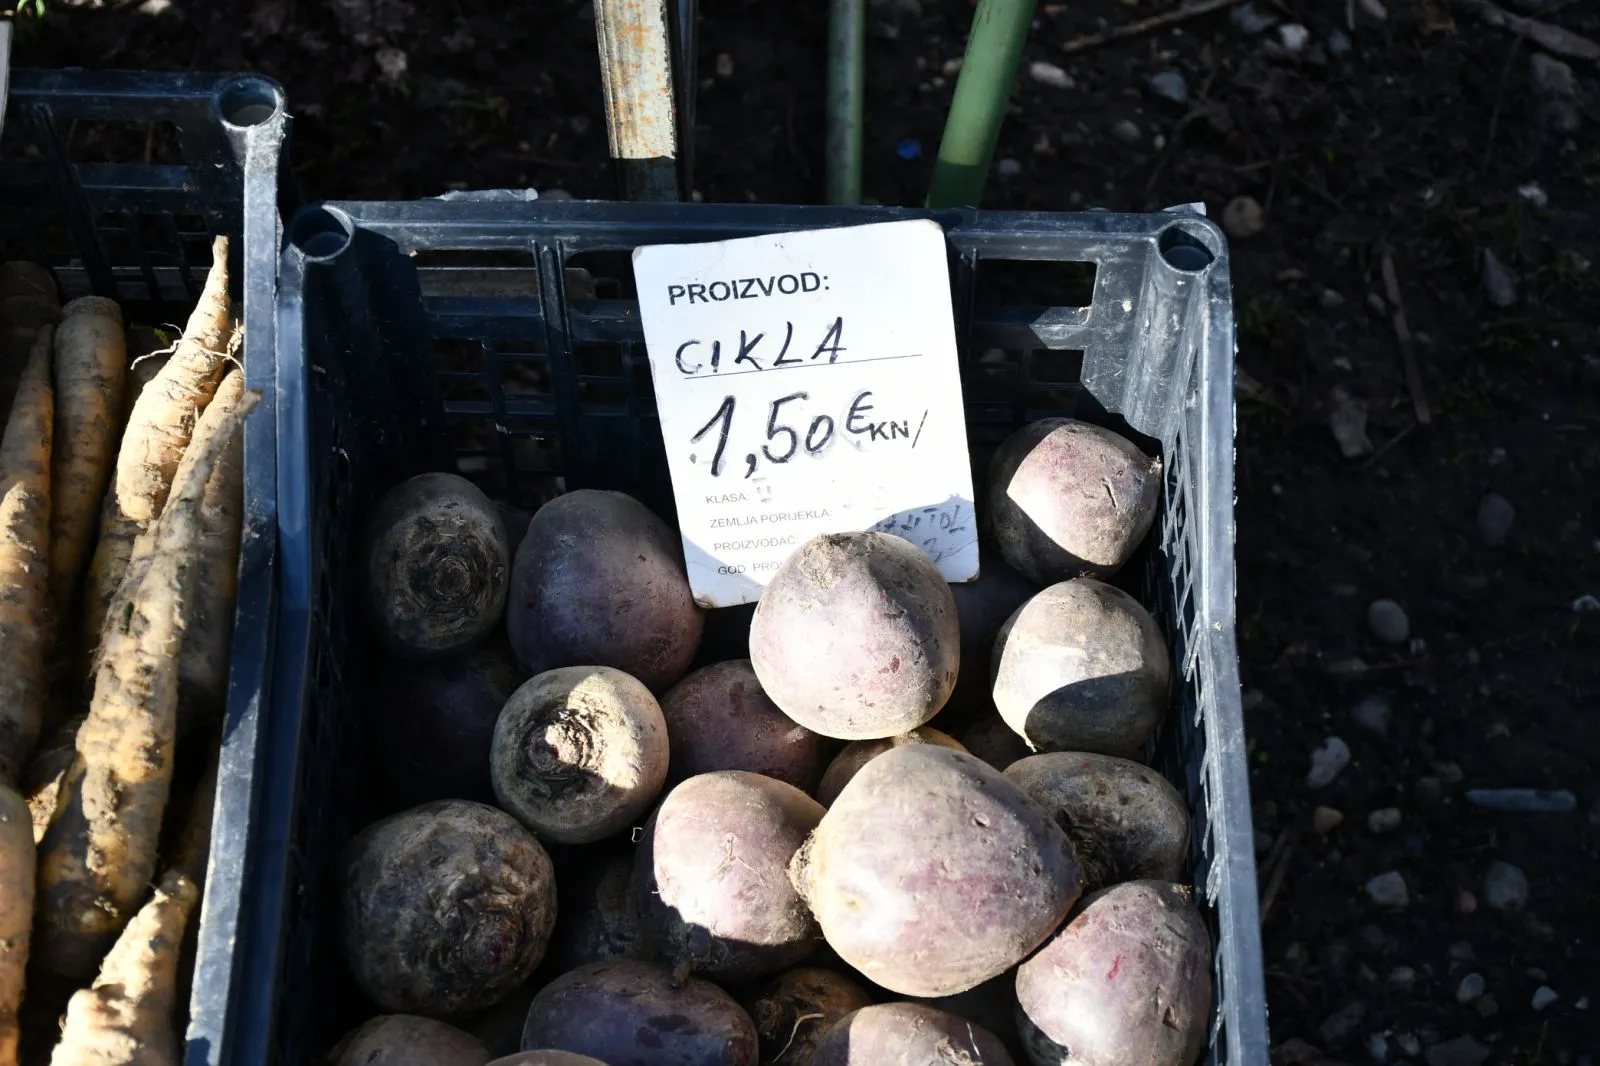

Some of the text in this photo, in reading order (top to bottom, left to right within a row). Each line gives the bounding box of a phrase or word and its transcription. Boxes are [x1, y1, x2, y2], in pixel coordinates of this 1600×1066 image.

[667, 271, 830, 306] PROIZVOD:
[675, 316, 847, 375] CIKLA
[690, 391, 836, 479] 1,50
[709, 516, 759, 529] ZEMLJA
